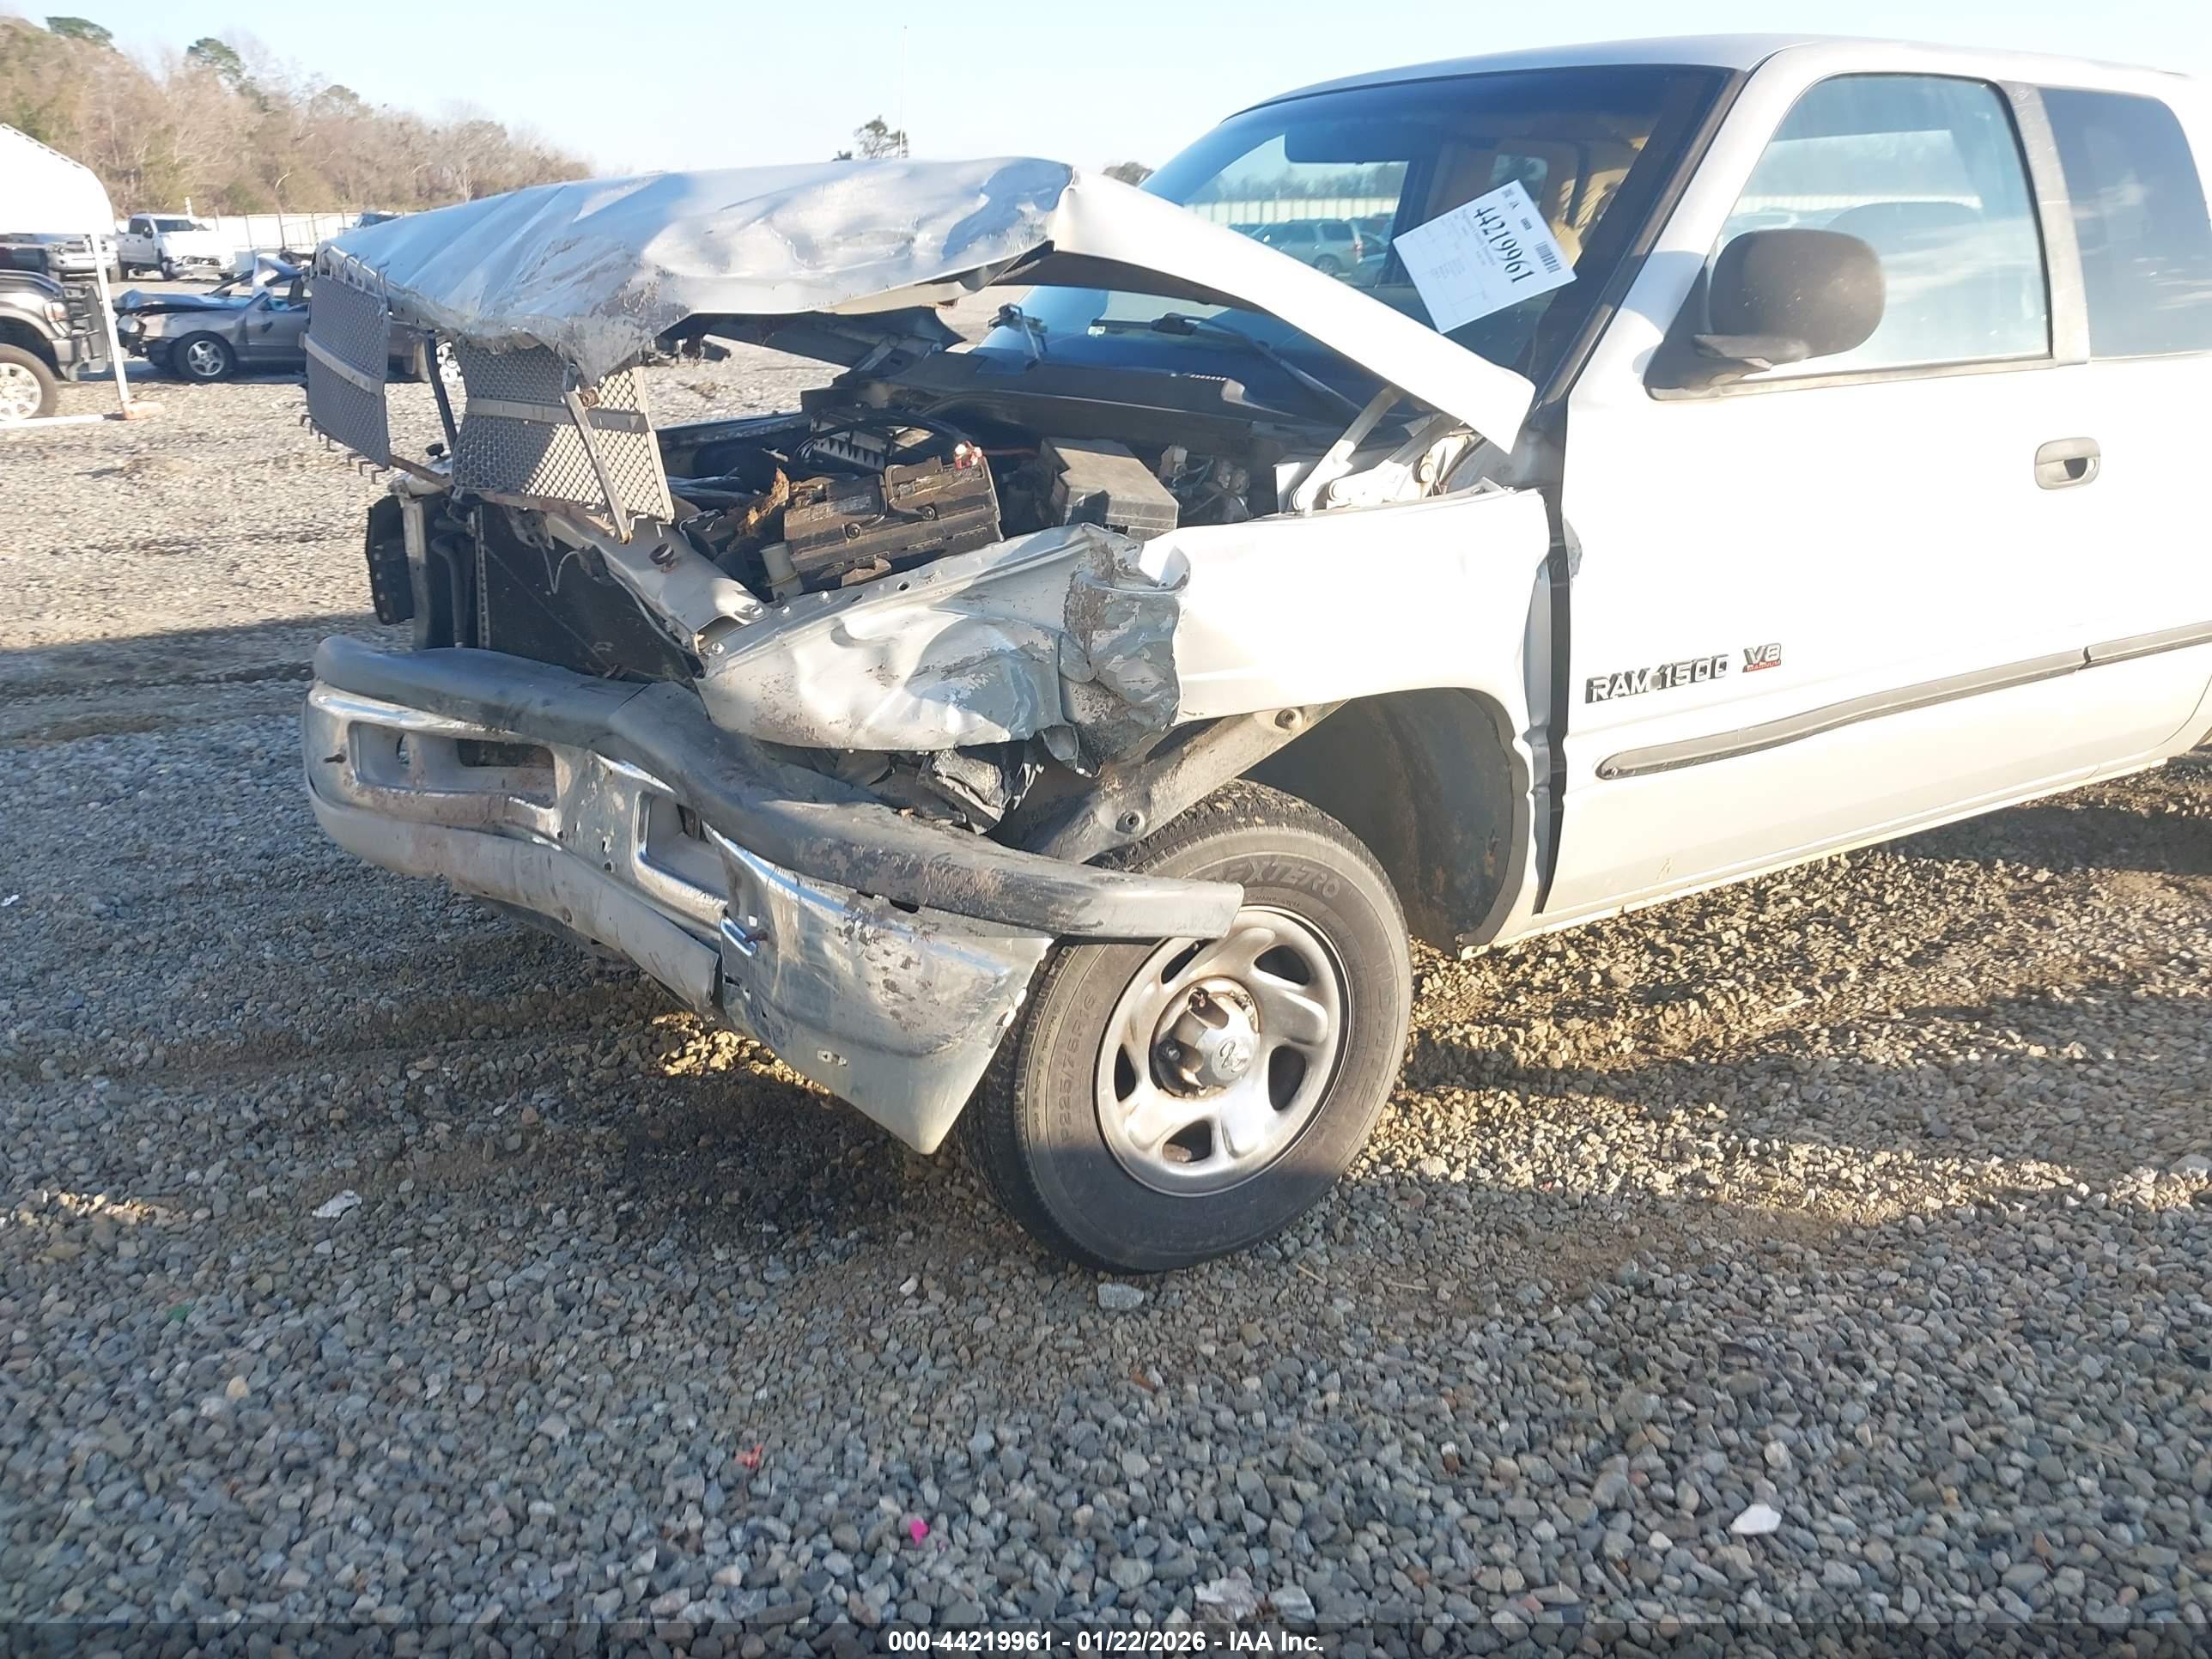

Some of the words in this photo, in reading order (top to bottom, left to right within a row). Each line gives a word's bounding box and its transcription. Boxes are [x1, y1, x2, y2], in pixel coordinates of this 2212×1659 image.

[1473, 206, 1535, 283] 44219961
[1743, 642, 1781, 665] V8
[1585, 667, 1650, 703] RAM
[1657, 654, 1729, 690] 1500
